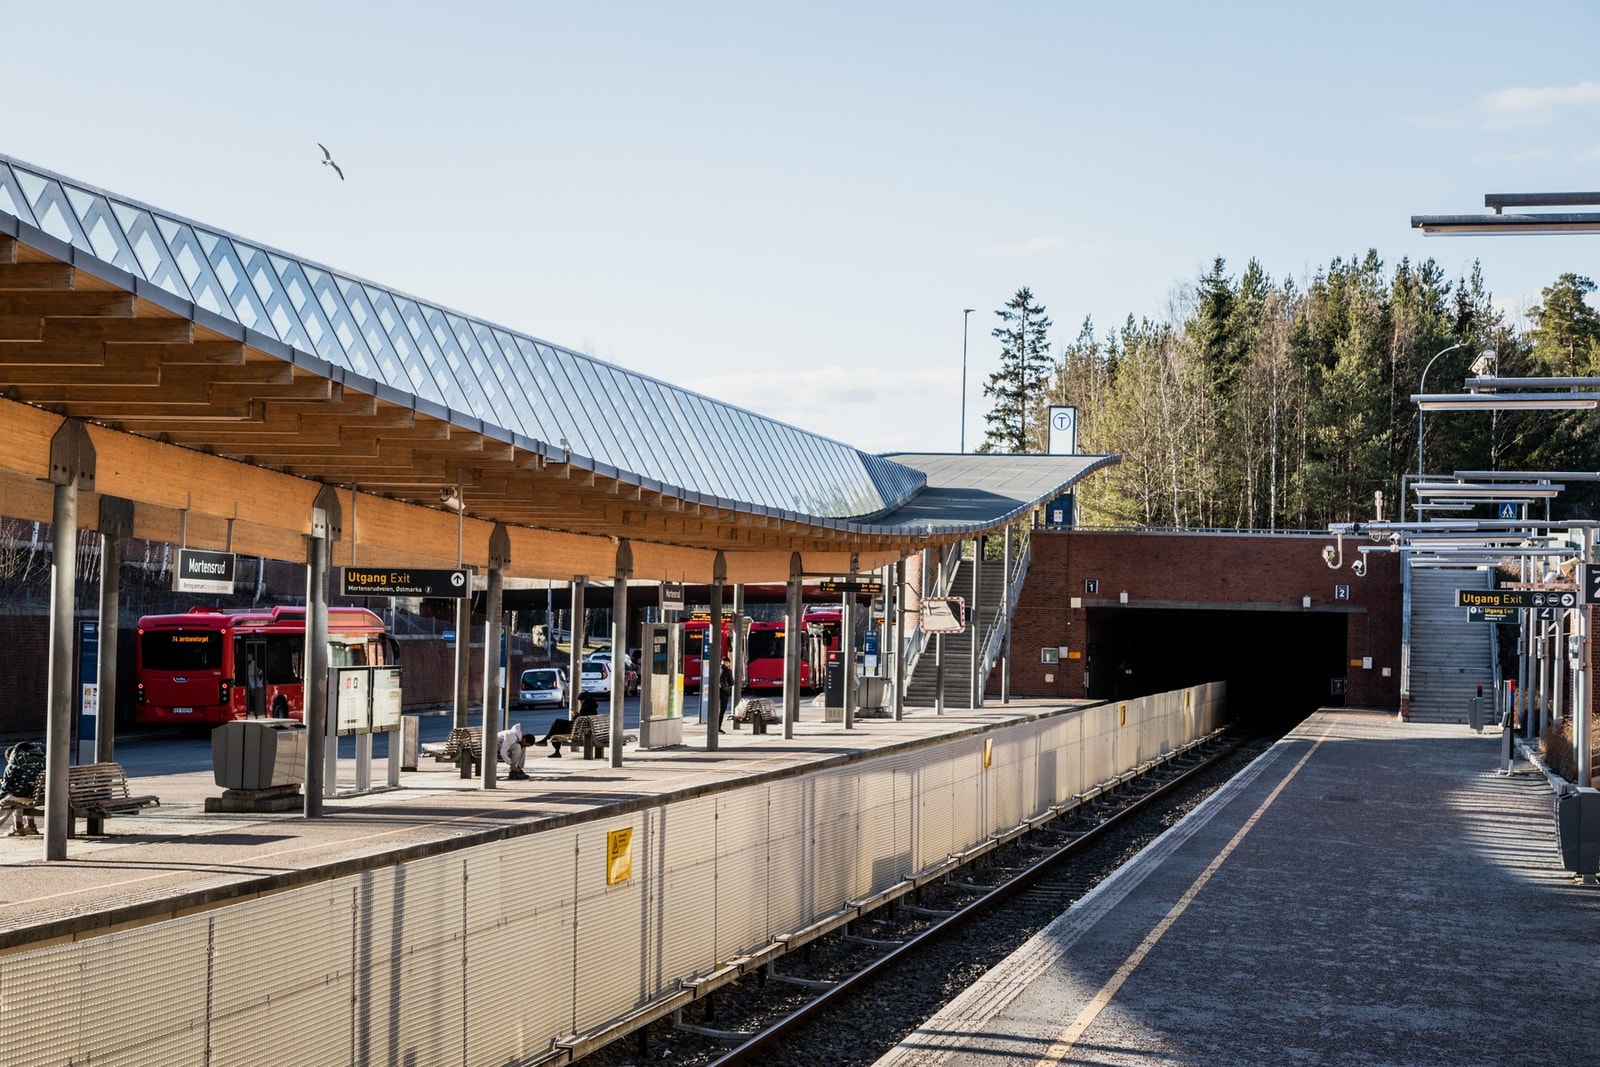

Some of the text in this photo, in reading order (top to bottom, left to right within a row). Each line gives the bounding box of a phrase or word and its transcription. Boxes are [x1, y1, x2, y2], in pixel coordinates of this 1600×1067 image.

[188, 557, 226, 575] Mortensrud
[348, 571, 411, 585] Utgang Exit
[348, 585, 422, 593] Mortensrudveien, Østmarka
[1089, 583, 1094, 592] 1
[1339, 589, 1345, 598] 2
[1462, 593, 1523, 606] Utgang Exit
